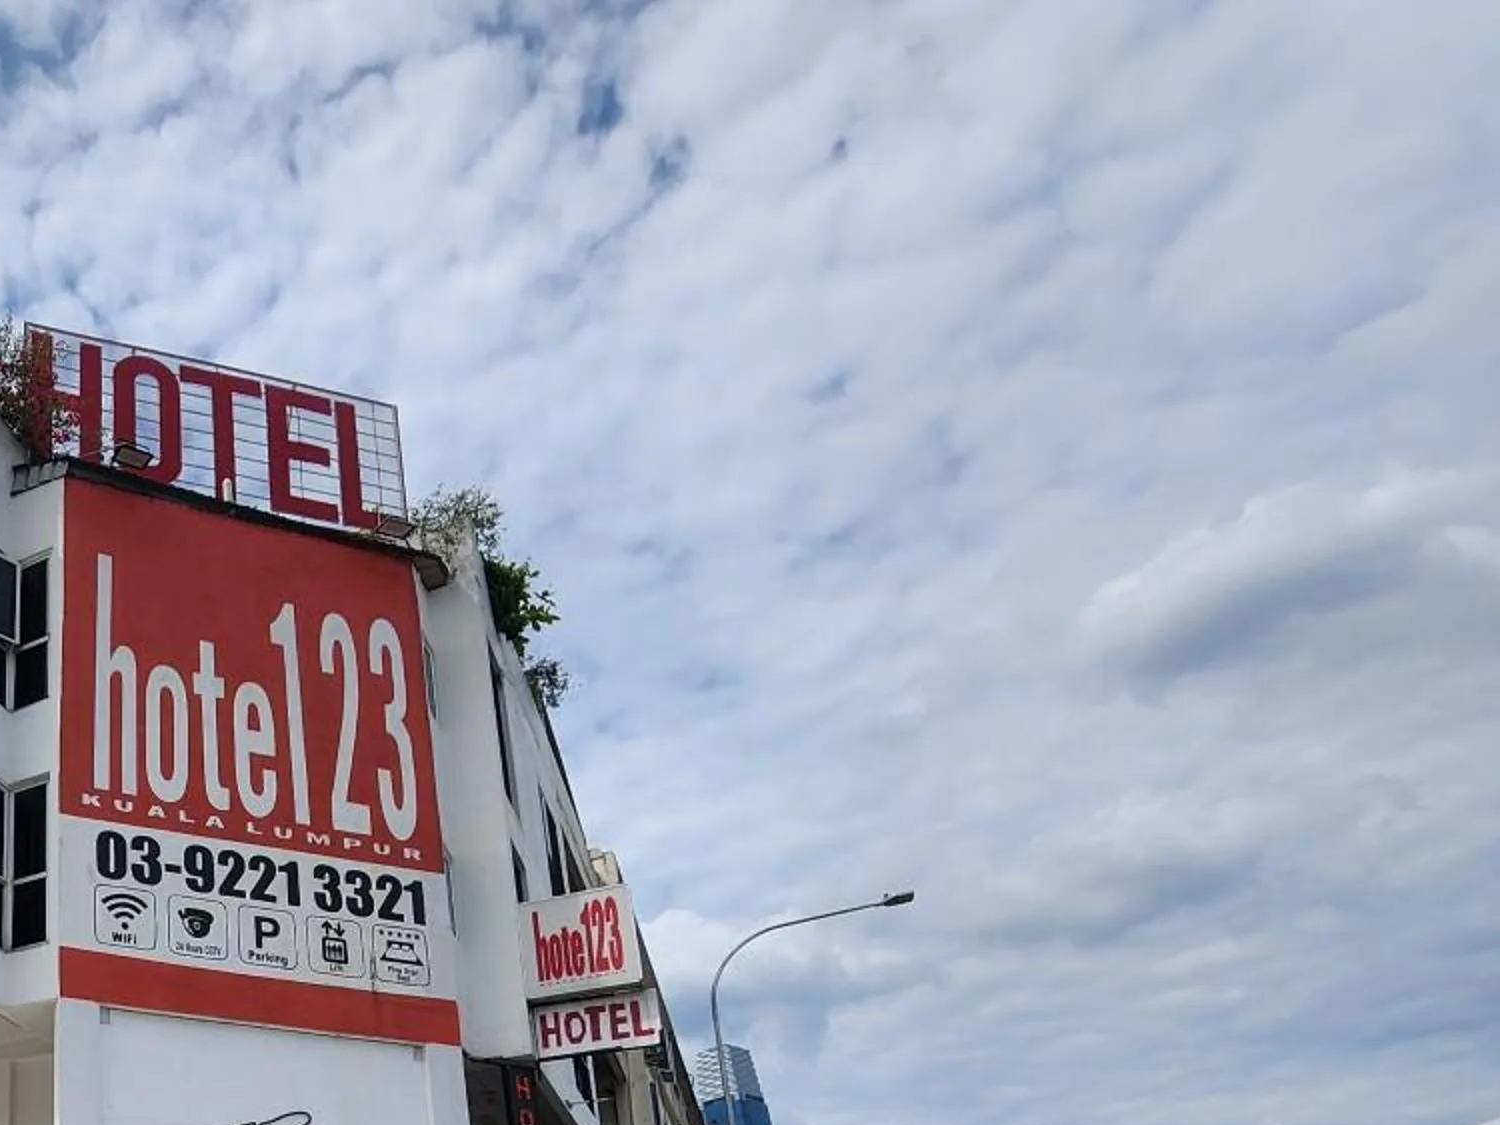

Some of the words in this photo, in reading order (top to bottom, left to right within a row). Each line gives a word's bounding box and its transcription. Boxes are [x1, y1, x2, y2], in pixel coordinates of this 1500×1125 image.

[29, 330, 383, 528] HOTEL
[82, 793, 225, 829] KUALA
[247, 821, 422, 861] LUMPUR
[95, 830, 301, 907] 03-9221
[313, 863, 427, 925] 3321
[248, 949, 289, 966] Parking
[538, 999, 655, 1049] HOTEL
